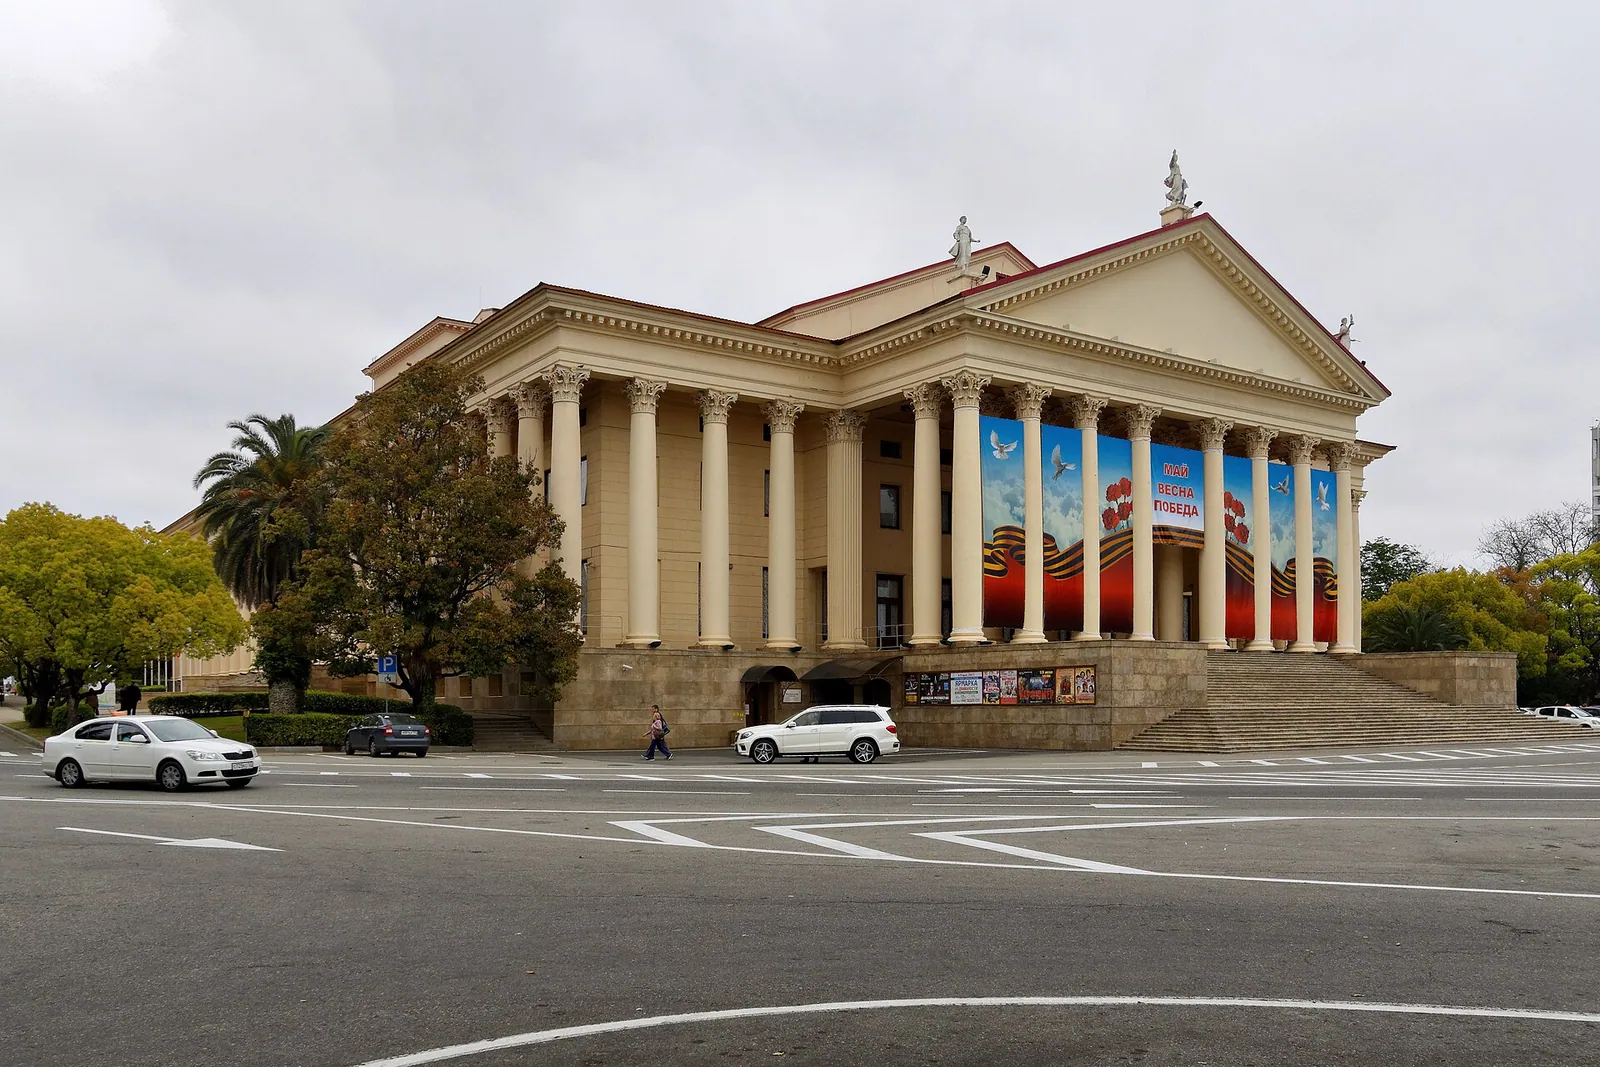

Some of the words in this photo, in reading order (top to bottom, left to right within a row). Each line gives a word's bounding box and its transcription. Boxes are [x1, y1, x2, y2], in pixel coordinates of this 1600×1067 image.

[1164, 463, 1189, 478] МАЙ
[1158, 483, 1194, 498] ВЕСНА
[1154, 500, 1199, 517] ПОБЕДА
[383, 657, 394, 671] P
